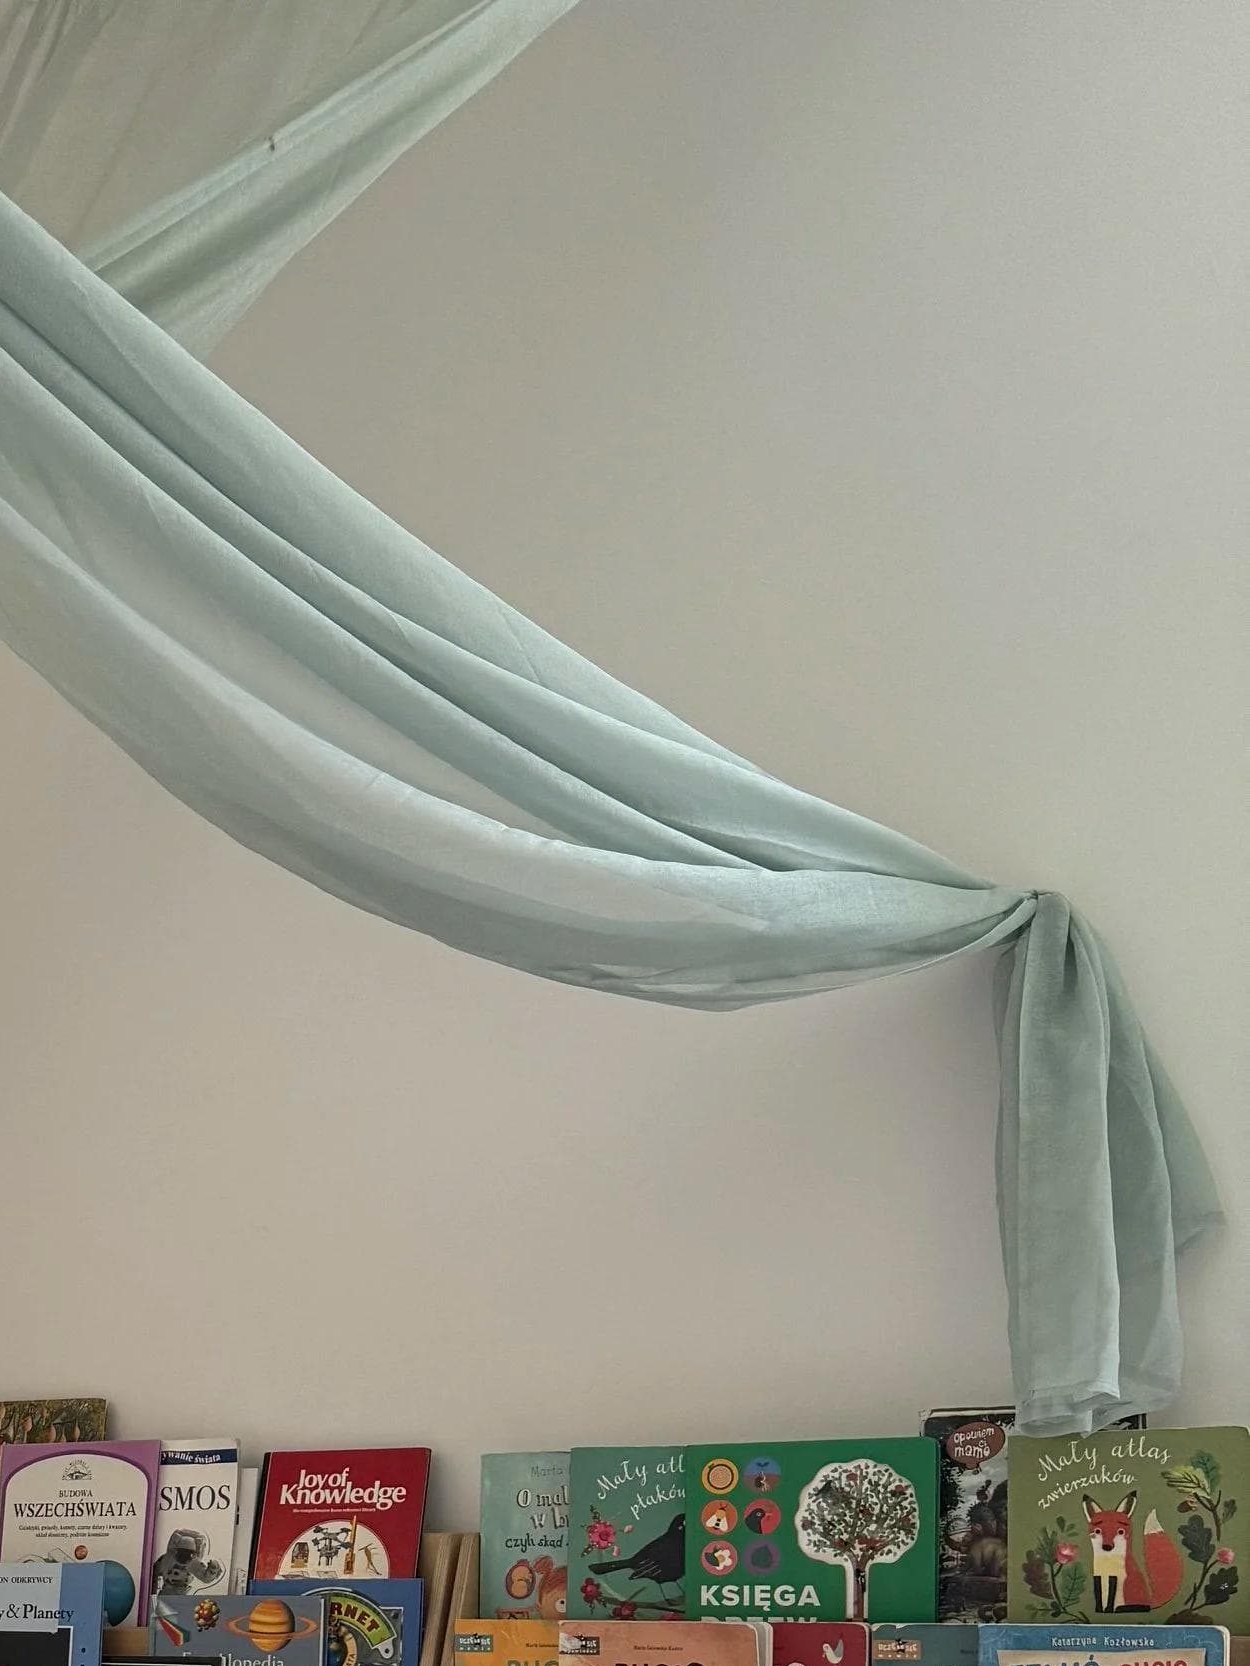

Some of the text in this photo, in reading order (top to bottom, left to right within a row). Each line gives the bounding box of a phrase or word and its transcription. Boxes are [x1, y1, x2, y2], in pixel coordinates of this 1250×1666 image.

[1037, 1436, 1172, 1482] Mały atlas
[299, 1467, 350, 1490] Joy of
[597, 1459, 649, 1500] Mały
[1037, 1467, 1138, 1511] zwierzaków
[59, 1489, 93, 1498] BUDOWA
[279, 1480, 407, 1510] Knowledge
[13, 1499, 137, 1518] WSZECHŚWIATA
[505, 1532, 535, 1554] czyli
[11, 1576, 53, 1584] ODKRYWCY
[700, 1584, 821, 1612] KSIĘGA
[6, 1604, 20, 1618] &
[22, 1603, 75, 1622] Planety
[1052, 1636, 1155, 1648] Katarzyna Kozłowska
